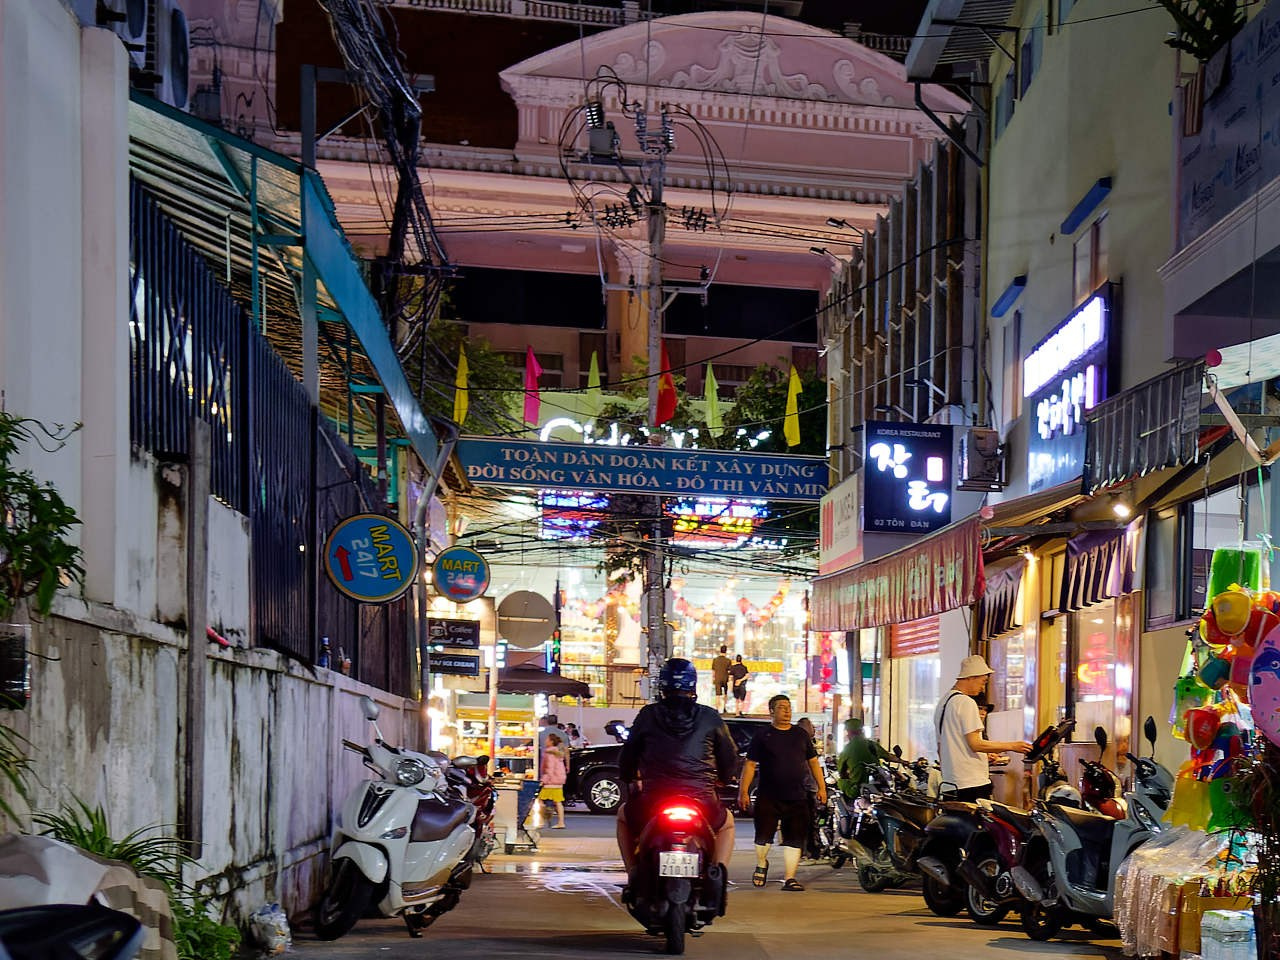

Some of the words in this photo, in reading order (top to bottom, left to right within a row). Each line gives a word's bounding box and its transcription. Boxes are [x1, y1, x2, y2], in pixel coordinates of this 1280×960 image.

[501, 448, 557, 464] TOÀN
[563, 450, 605, 466] DÂN
[671, 455, 711, 472] KẾT
[715, 458, 759, 474] XÂY
[509, 463, 565, 482] SỐNG
[572, 469, 612, 485] VĂN
[710, 478, 744, 495] THỊ
[750, 479, 789, 494] VĂN
[369, 525, 402, 581] MART
[441, 559, 480, 573] MART
